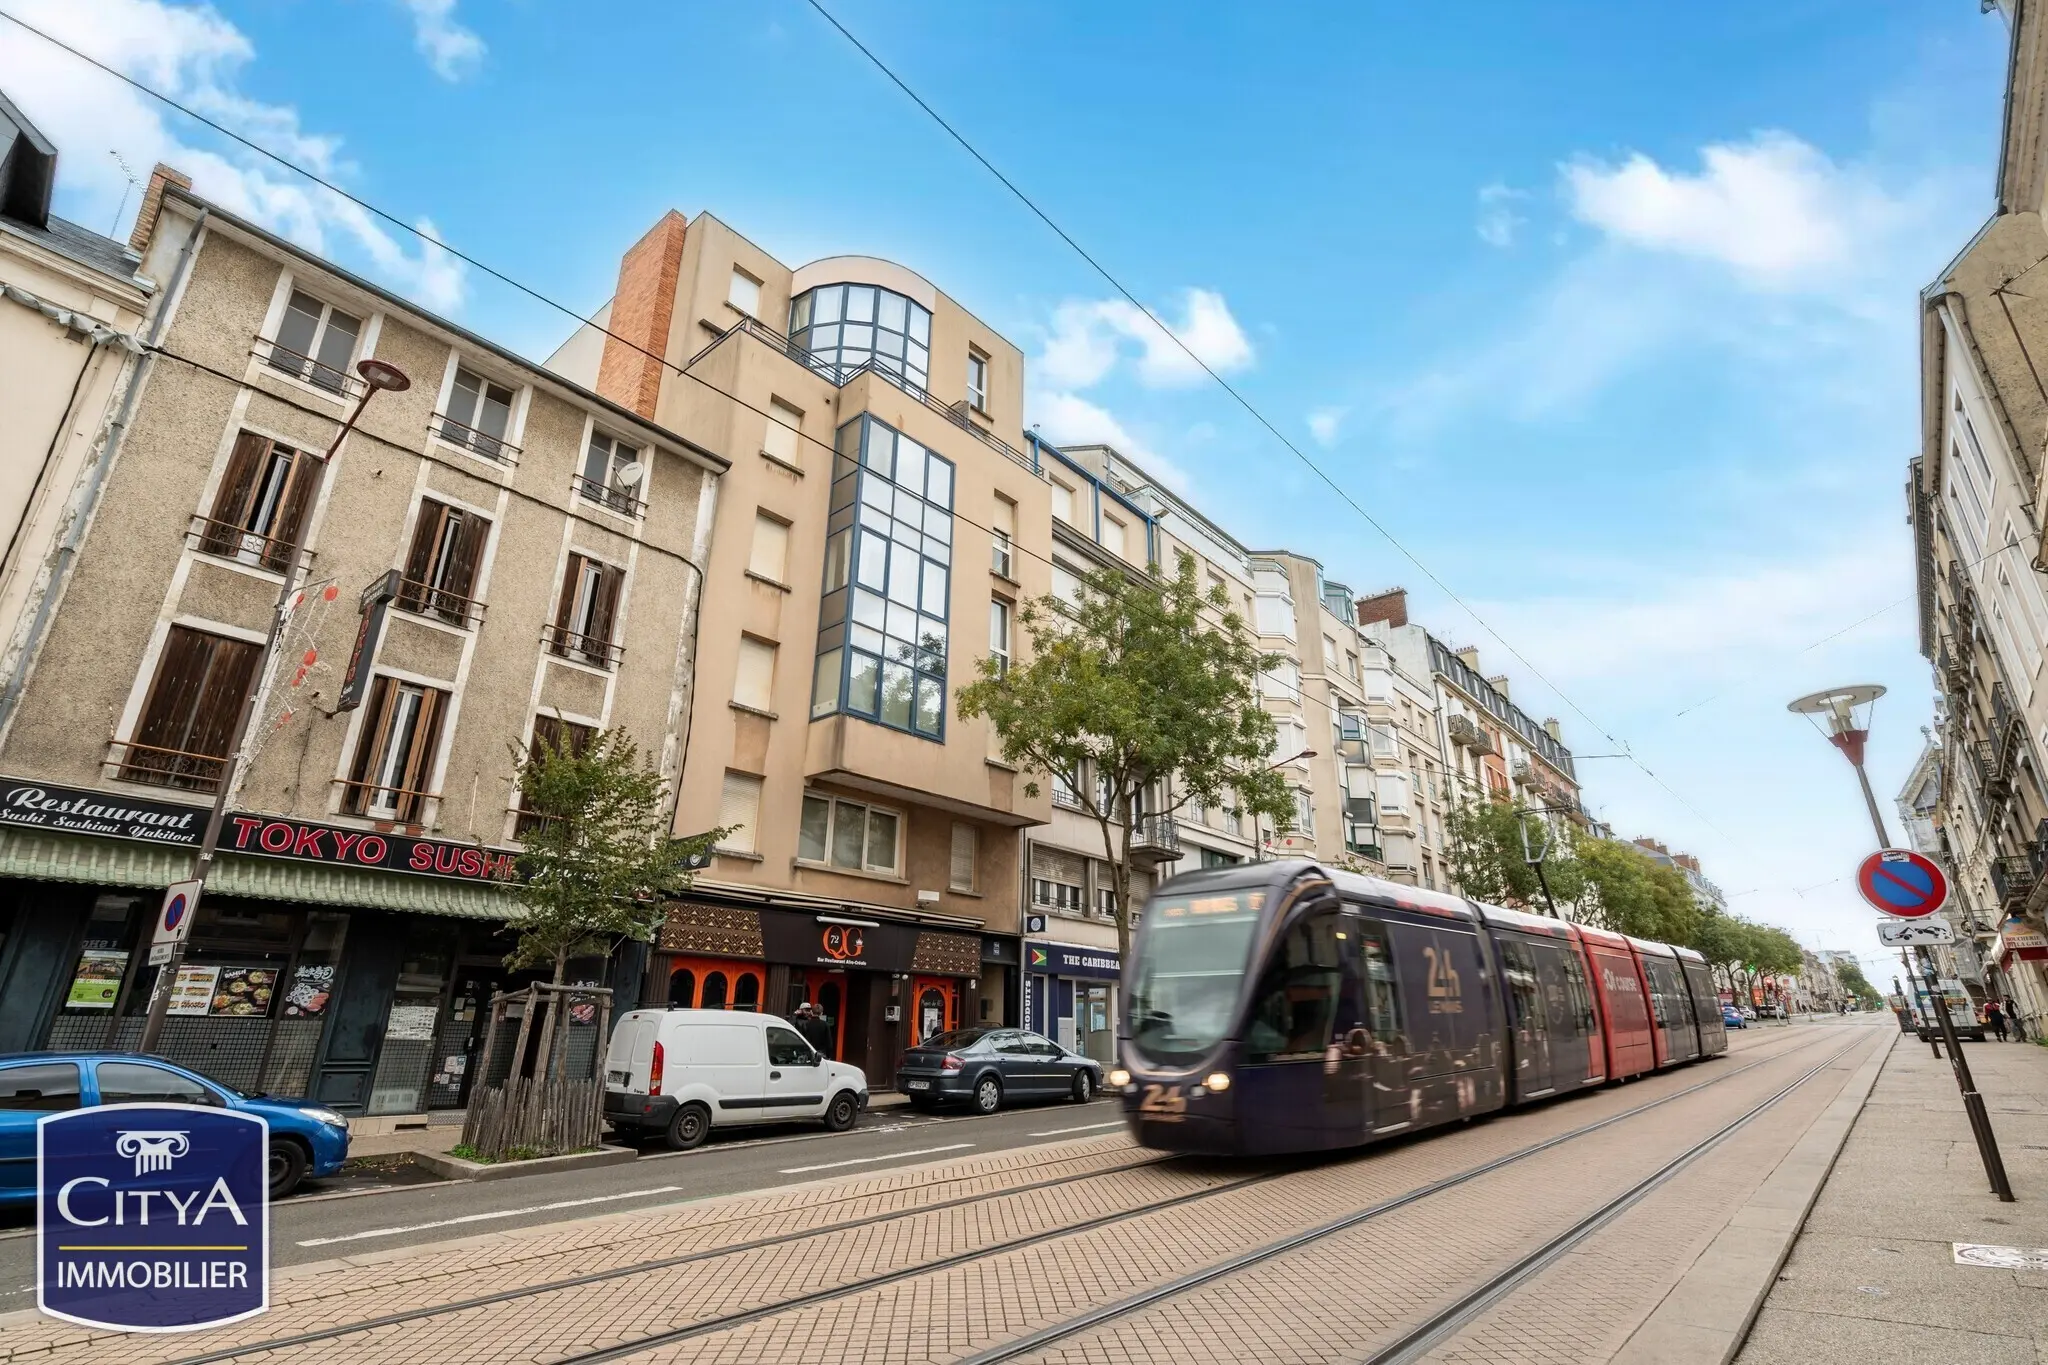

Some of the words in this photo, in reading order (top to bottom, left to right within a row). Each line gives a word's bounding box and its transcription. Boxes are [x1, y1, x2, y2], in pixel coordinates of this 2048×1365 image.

[0, 808, 47, 824] Sushi
[53, 815, 121, 834] Sashimi
[128, 824, 195, 843] Yakitori
[6, 787, 194, 830] Restaurant
[232, 817, 387, 864] TOKYO
[408, 842, 515, 882] SUSHI
[823, 925, 864, 959] QG
[830, 935, 839, 944] 72
[1063, 954, 1080, 966] THE
[1081, 957, 1120, 970] CARIBBEA
